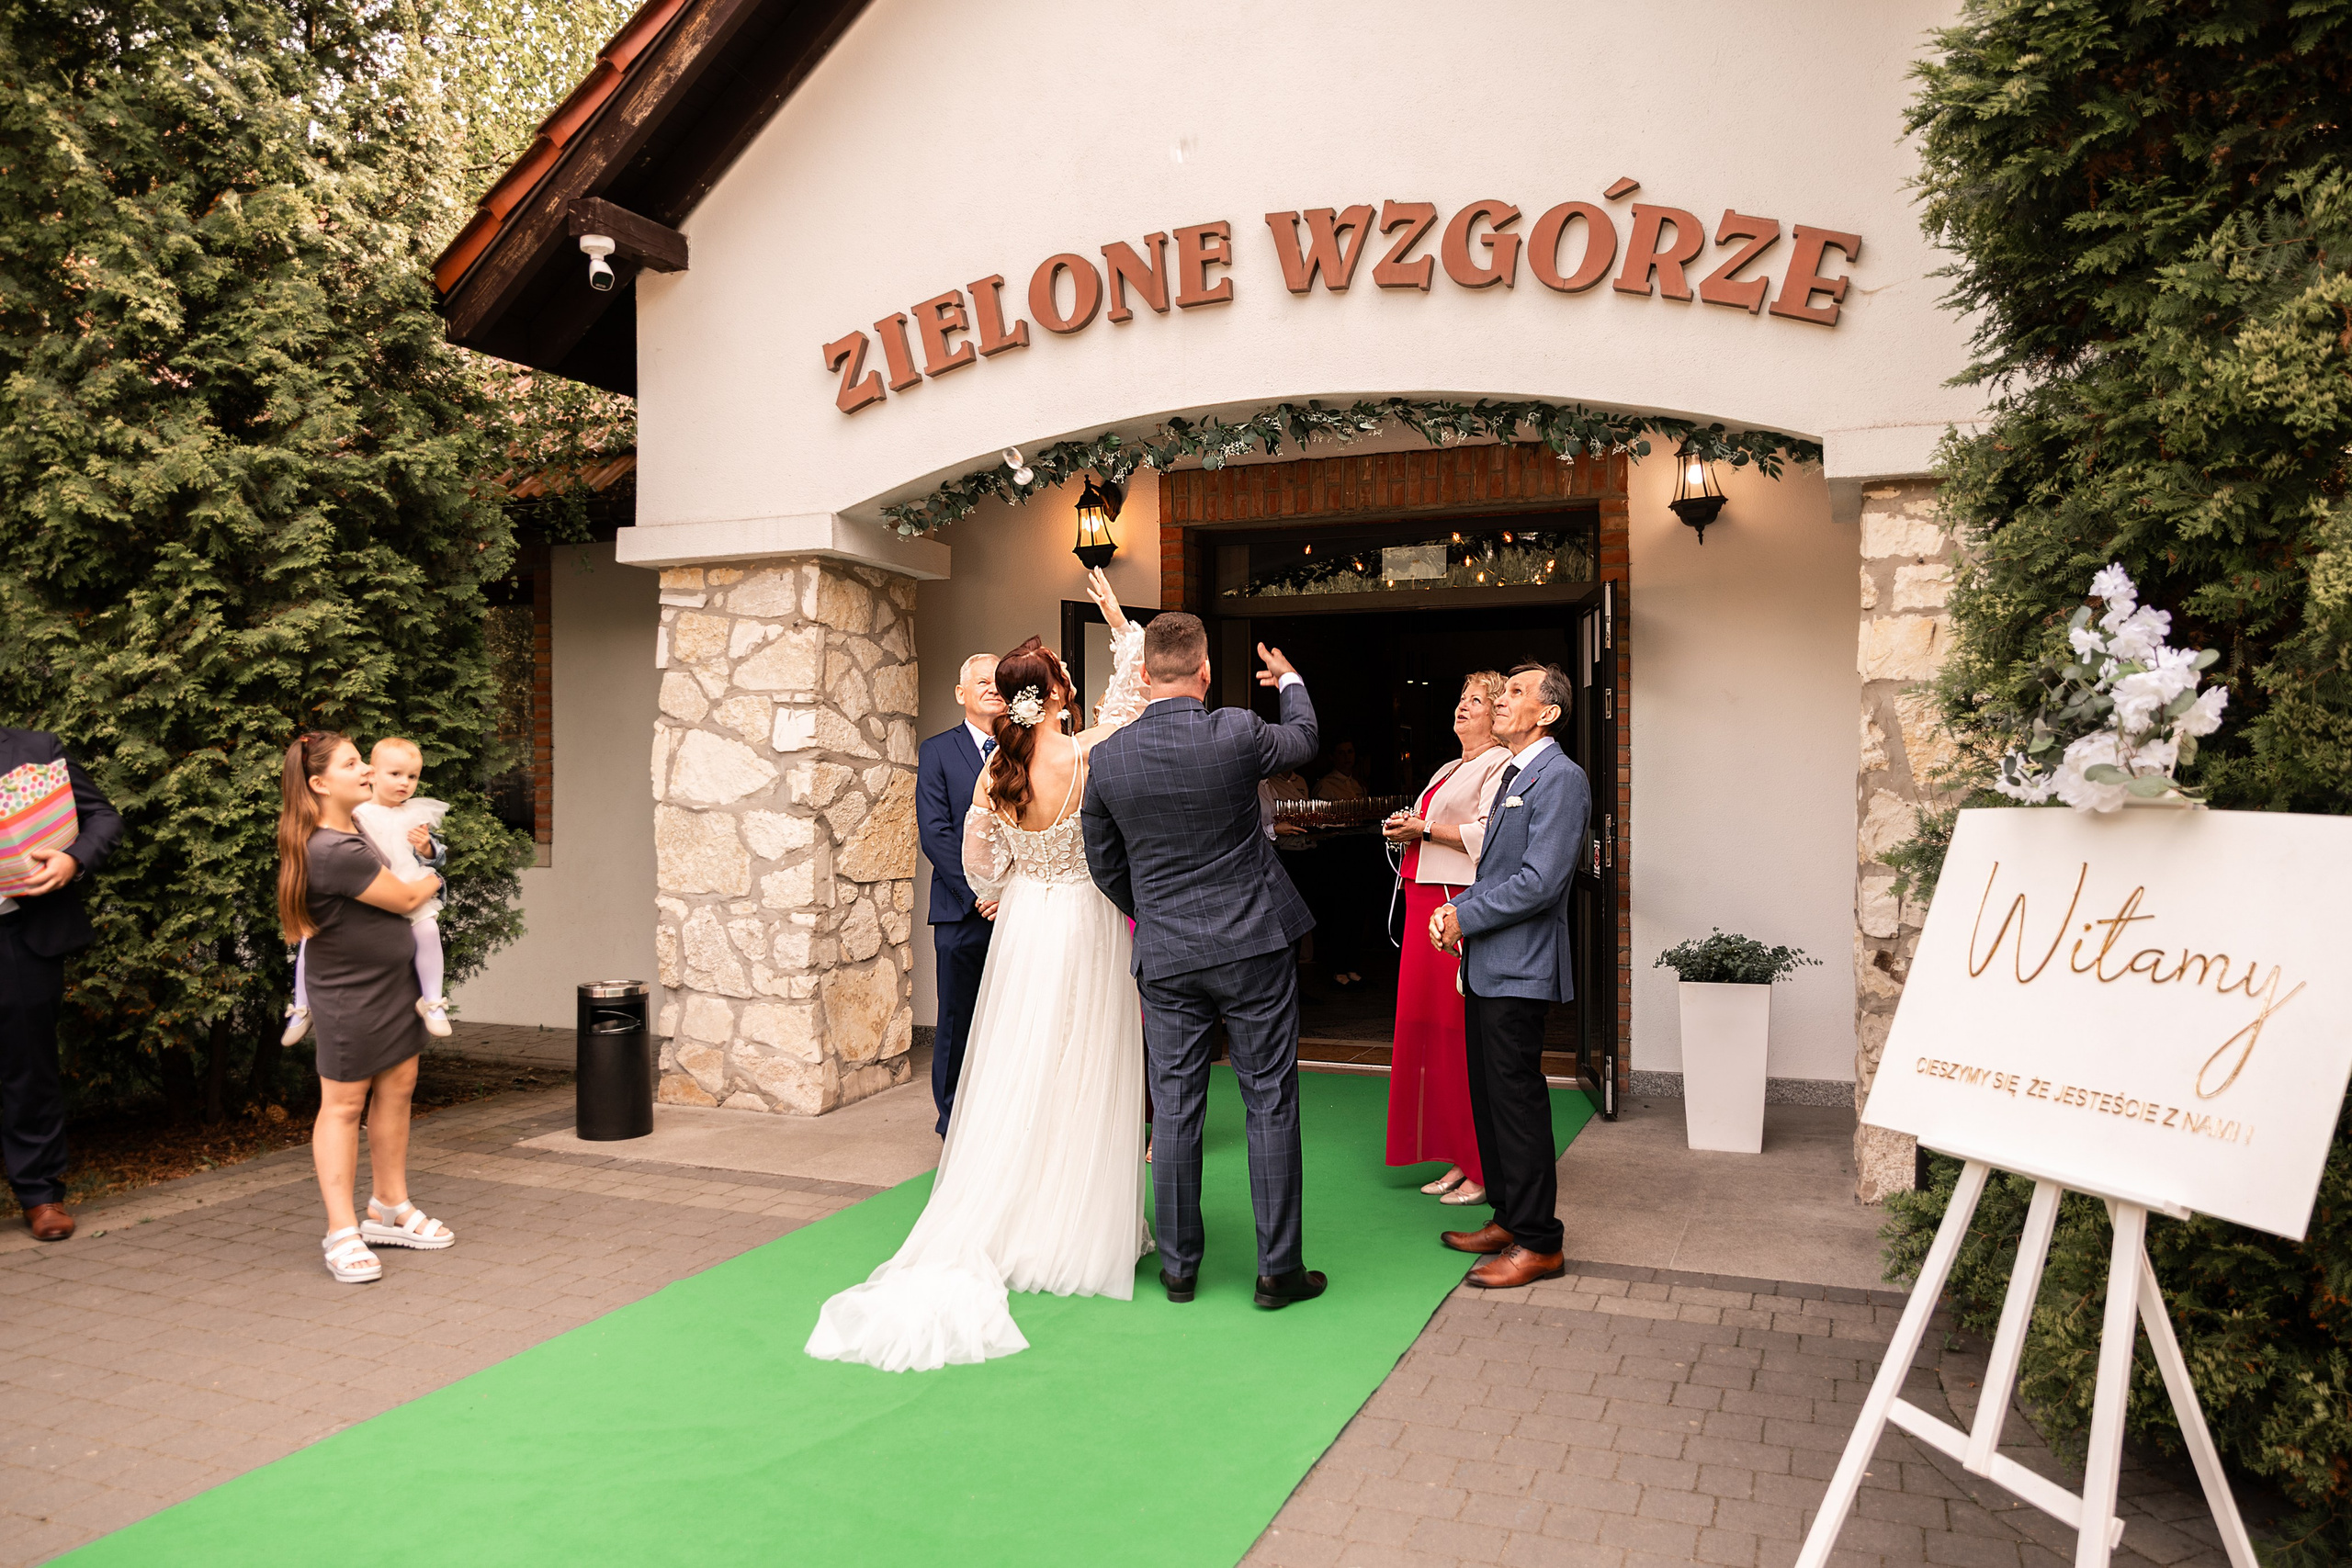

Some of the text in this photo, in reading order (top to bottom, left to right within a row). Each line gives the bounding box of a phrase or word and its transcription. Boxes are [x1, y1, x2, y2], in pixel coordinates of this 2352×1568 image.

[822, 175, 1861, 414] ZIELONE WZGÓRZE
[1916, 1056, 1992, 1086] CIESZYMY
[1992, 1071, 2020, 1097] SIĘ
[2026, 1077, 2052, 1099] ŻE
[2053, 1084, 2160, 1122] JESTEŚCIE
[2162, 1107, 2178, 1127] Z
[1969, 861, 2307, 1100] Witamy
